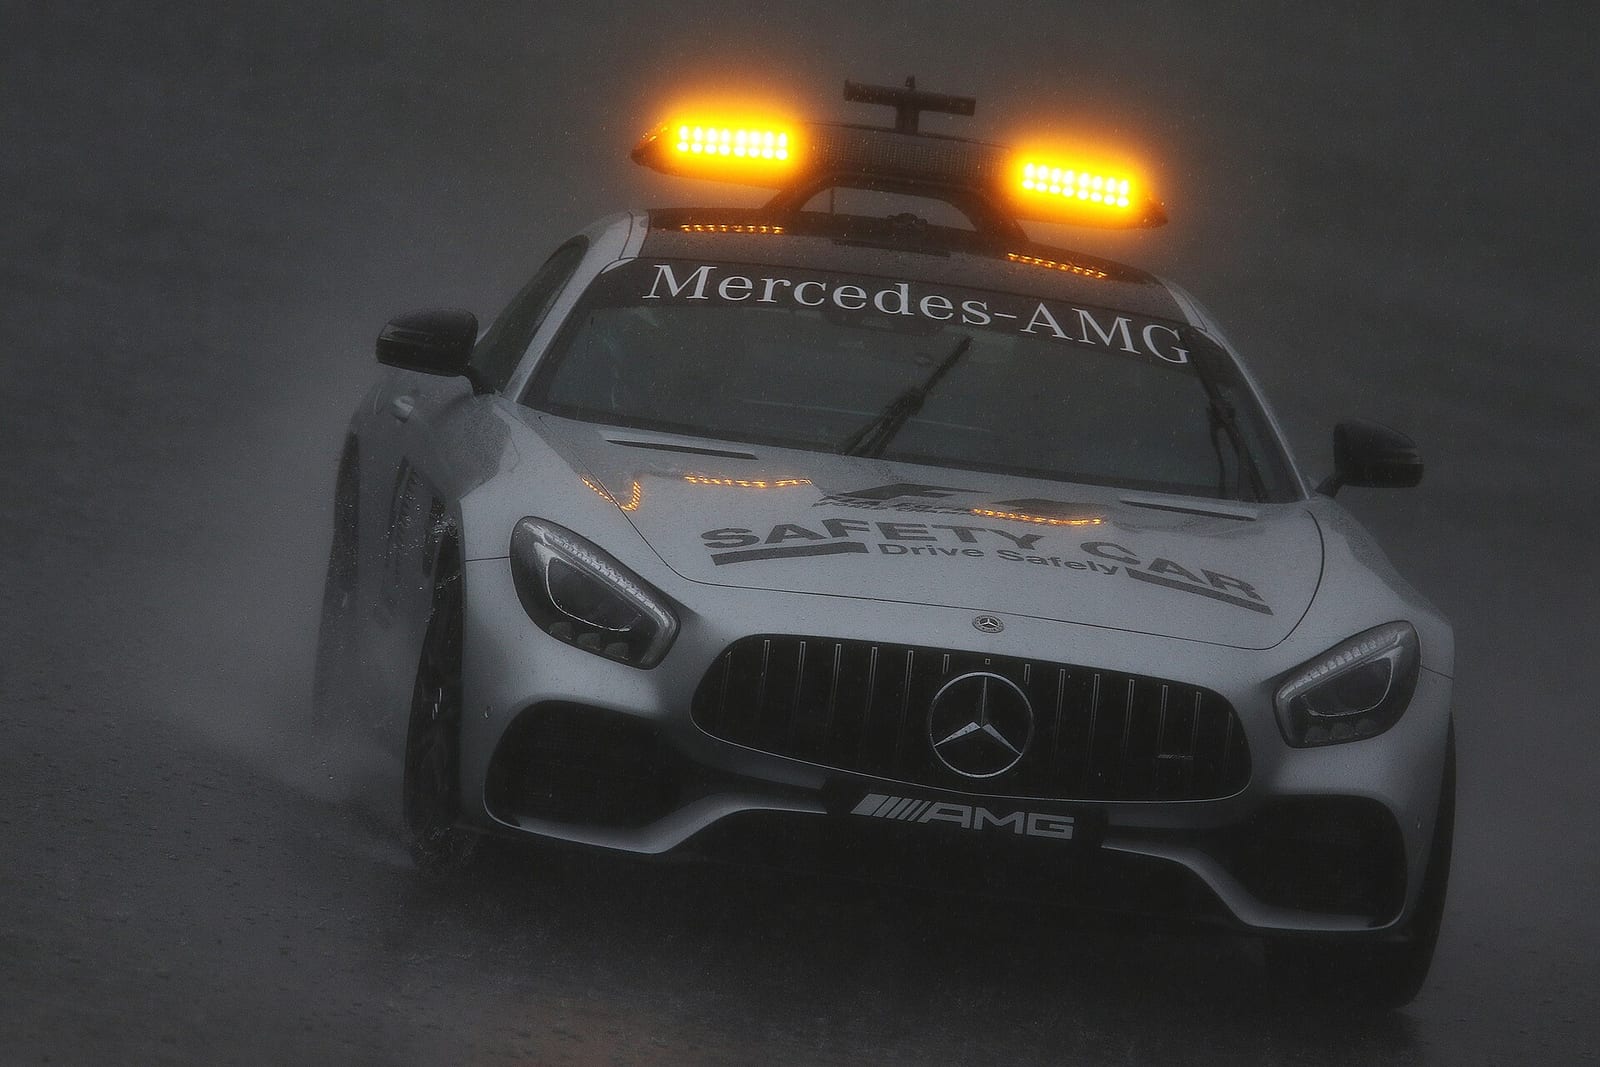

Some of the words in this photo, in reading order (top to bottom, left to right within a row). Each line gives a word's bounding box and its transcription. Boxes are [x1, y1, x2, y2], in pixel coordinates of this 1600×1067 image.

[641, 264, 1190, 364] Mercedes-AMG
[701, 518, 1045, 551] SAFETY
[1081, 540, 1265, 602] CAR
[878, 541, 984, 559] Drive
[998, 549, 1120, 576] Safely
